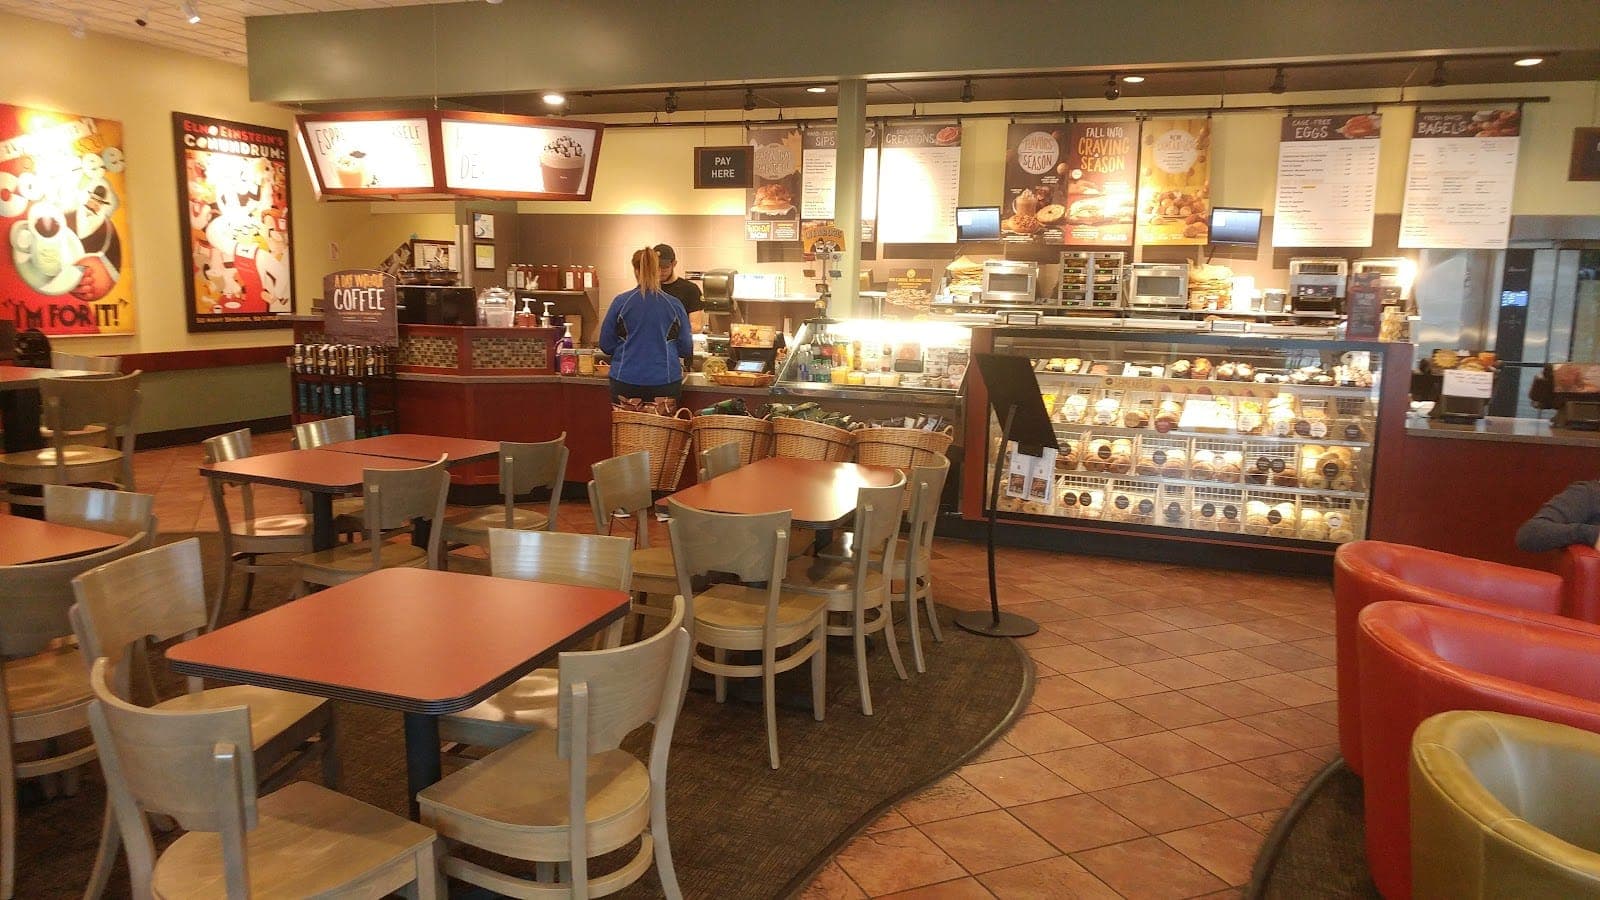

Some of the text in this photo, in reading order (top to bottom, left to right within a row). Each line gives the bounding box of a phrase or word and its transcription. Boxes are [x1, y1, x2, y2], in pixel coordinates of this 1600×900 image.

[1086, 127, 1123, 138] FALL INTO
[1295, 126, 1328, 138] EGGS
[1418, 121, 1467, 135] BAGELS
[815, 137, 835, 147] SIPS
[886, 133, 935, 145] CREATIONS
[1078, 137, 1130, 155] CRAVING
[715, 157, 731, 166] PAY
[1023, 154, 1053, 171] SEASON
[1080, 156, 1125, 173] SEASON
[711, 169, 735, 178] HERE
[334, 288, 386, 312] COFFEE
[48, 304, 94, 328] FOR
